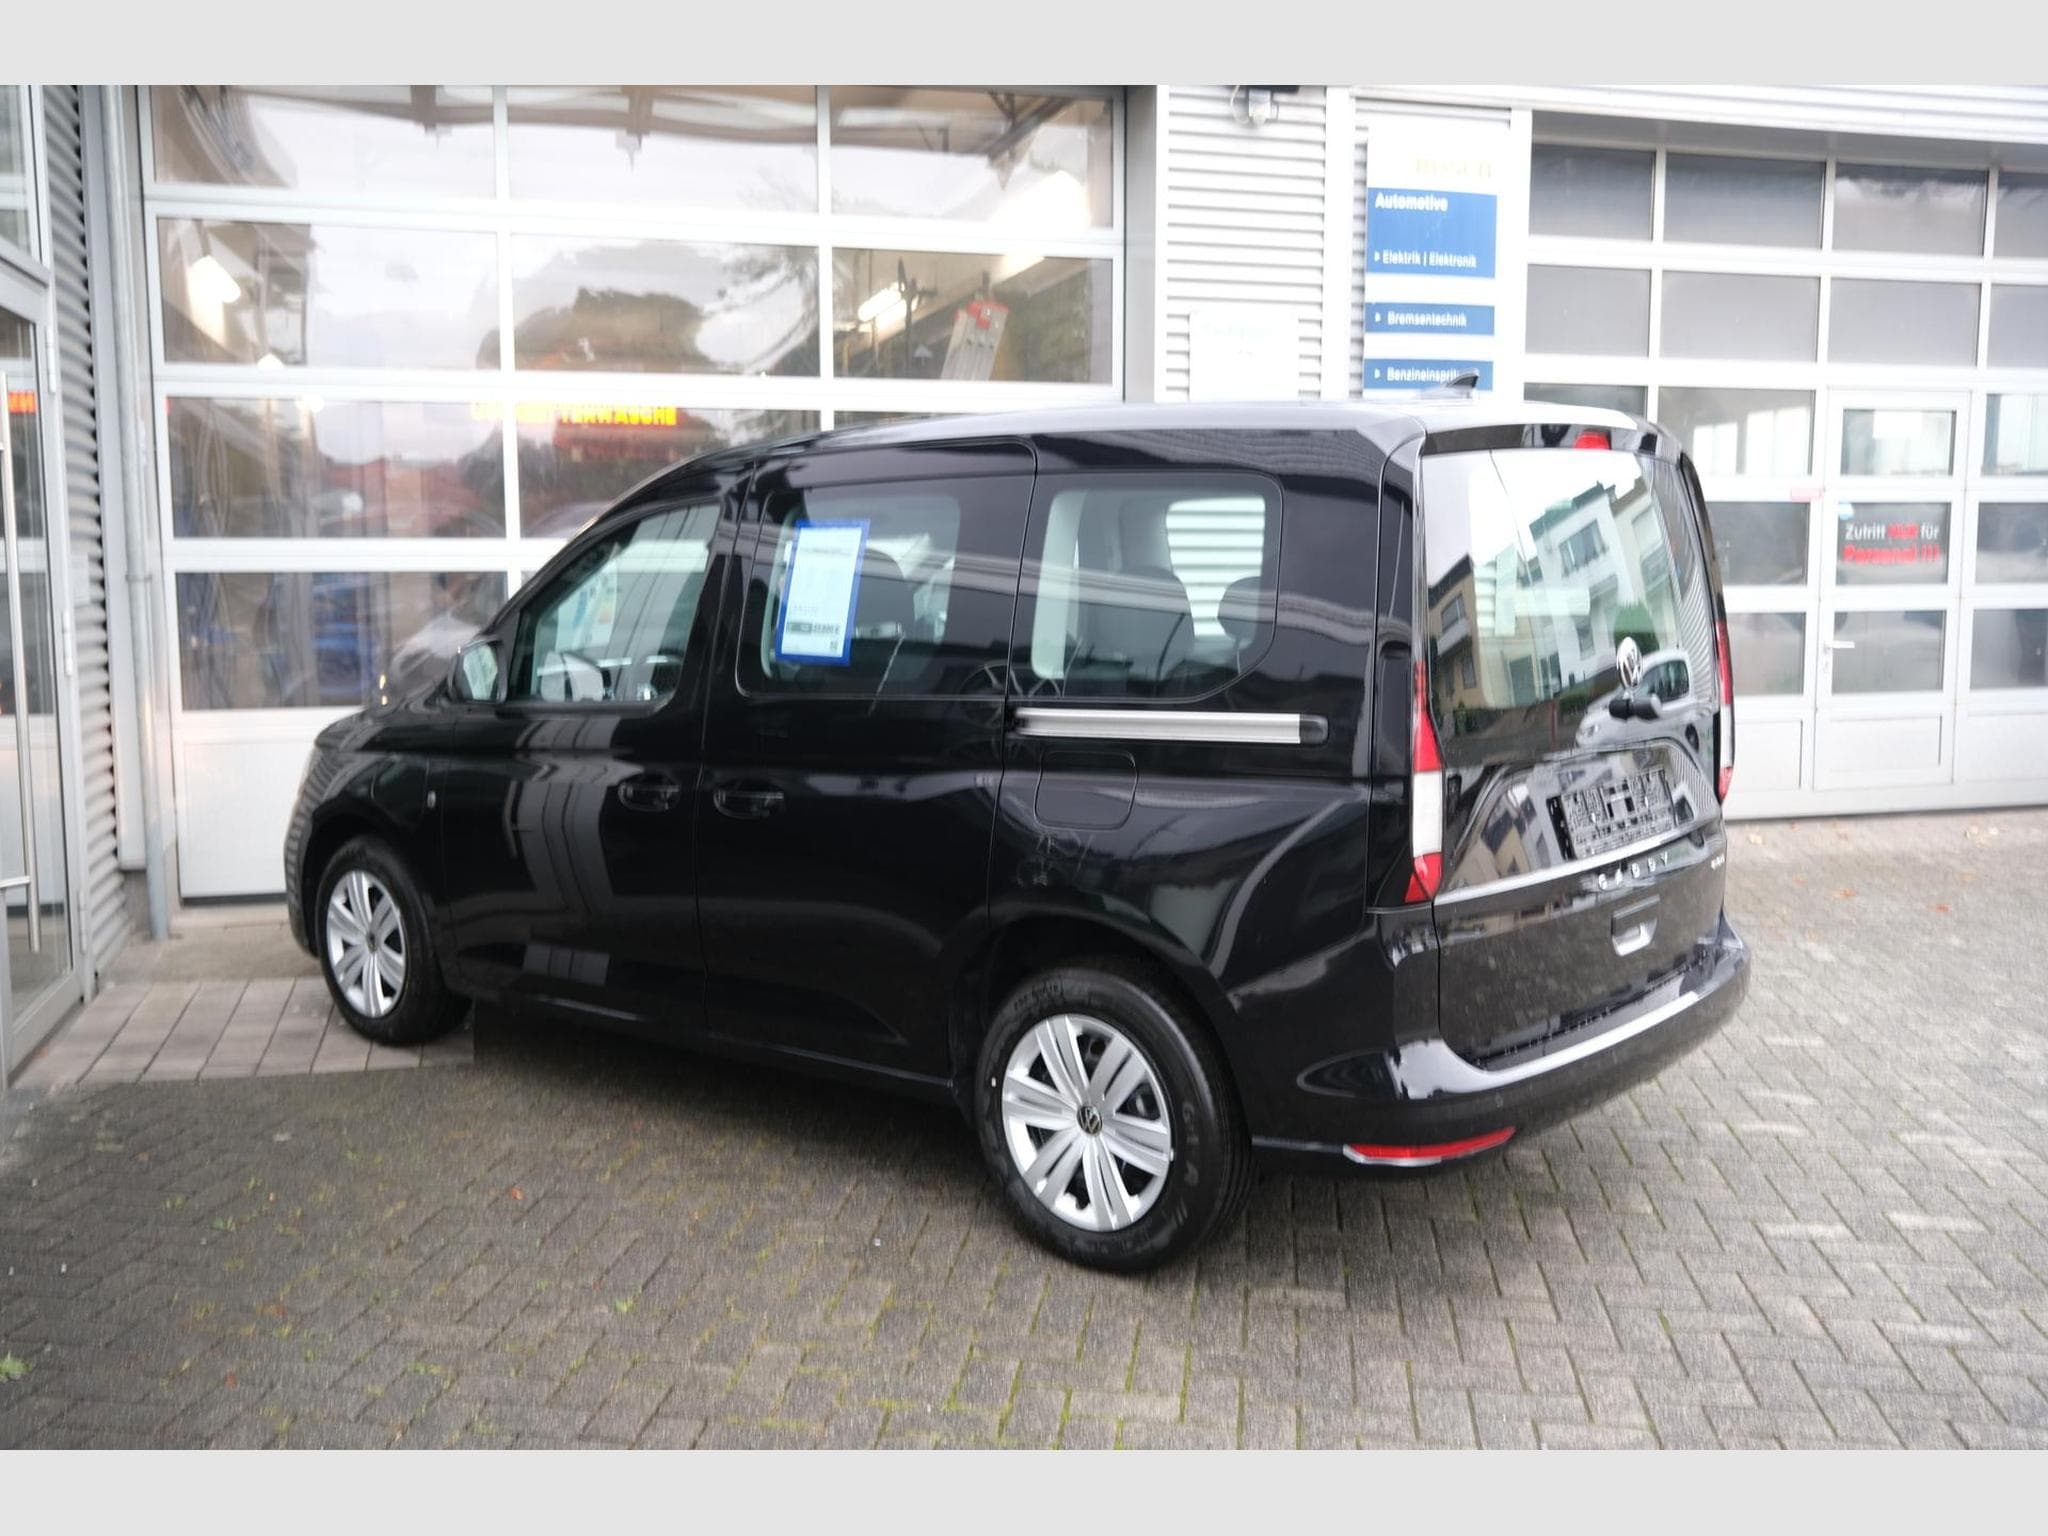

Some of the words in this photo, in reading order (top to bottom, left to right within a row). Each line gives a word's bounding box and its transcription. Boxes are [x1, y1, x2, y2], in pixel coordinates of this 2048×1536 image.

[1375, 192, 1449, 212] Automotive
[1382, 249, 1421, 265] Elektrik
[1429, 251, 1477, 269] Elektronik
[1387, 311, 1467, 327] Bremsentechnik
[1845, 521, 1886, 540] Zutritt
[1920, 521, 1940, 540] für
